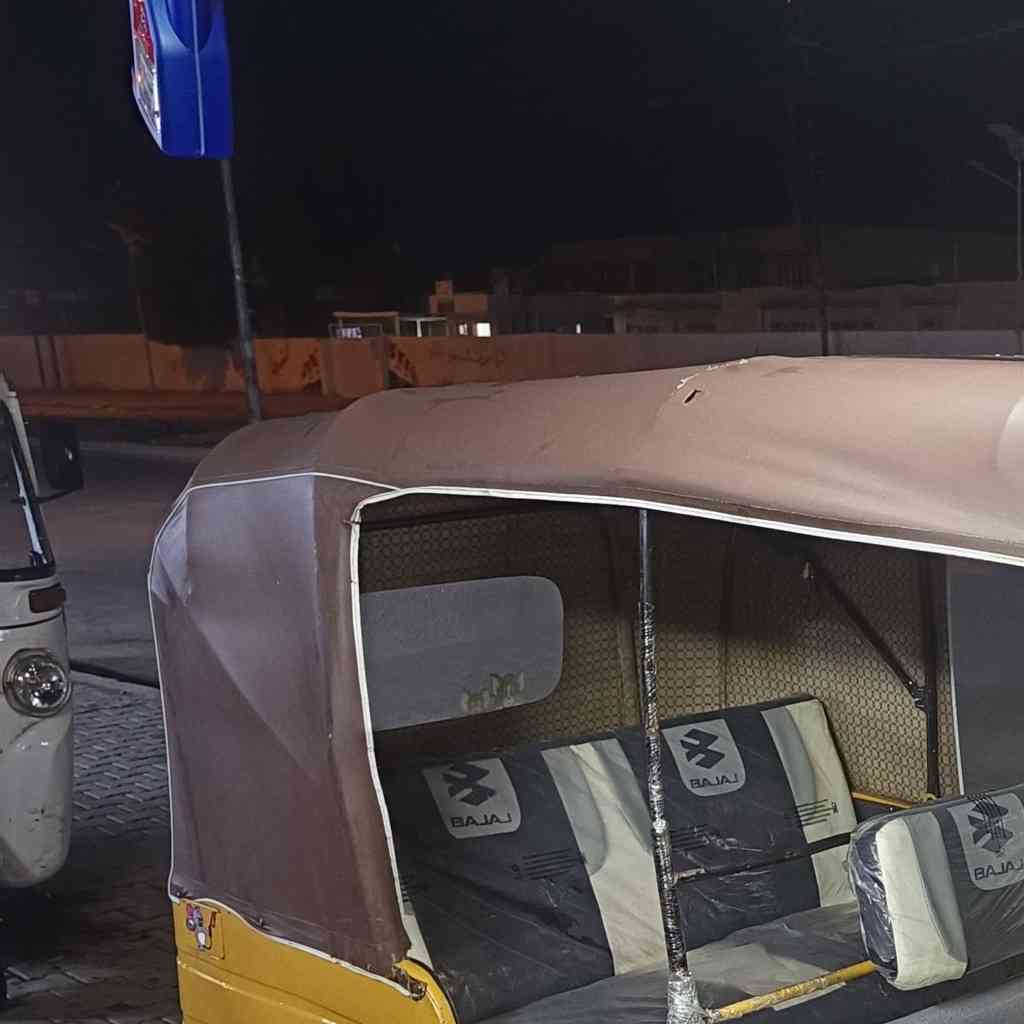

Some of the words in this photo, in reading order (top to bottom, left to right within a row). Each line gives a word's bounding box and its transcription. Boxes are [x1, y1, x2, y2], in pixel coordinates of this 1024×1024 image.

[690, 773, 738, 789] BAJAJ
[450, 812, 513, 828] BAJAJ
[974, 858, 1024, 880] BAJAJ
